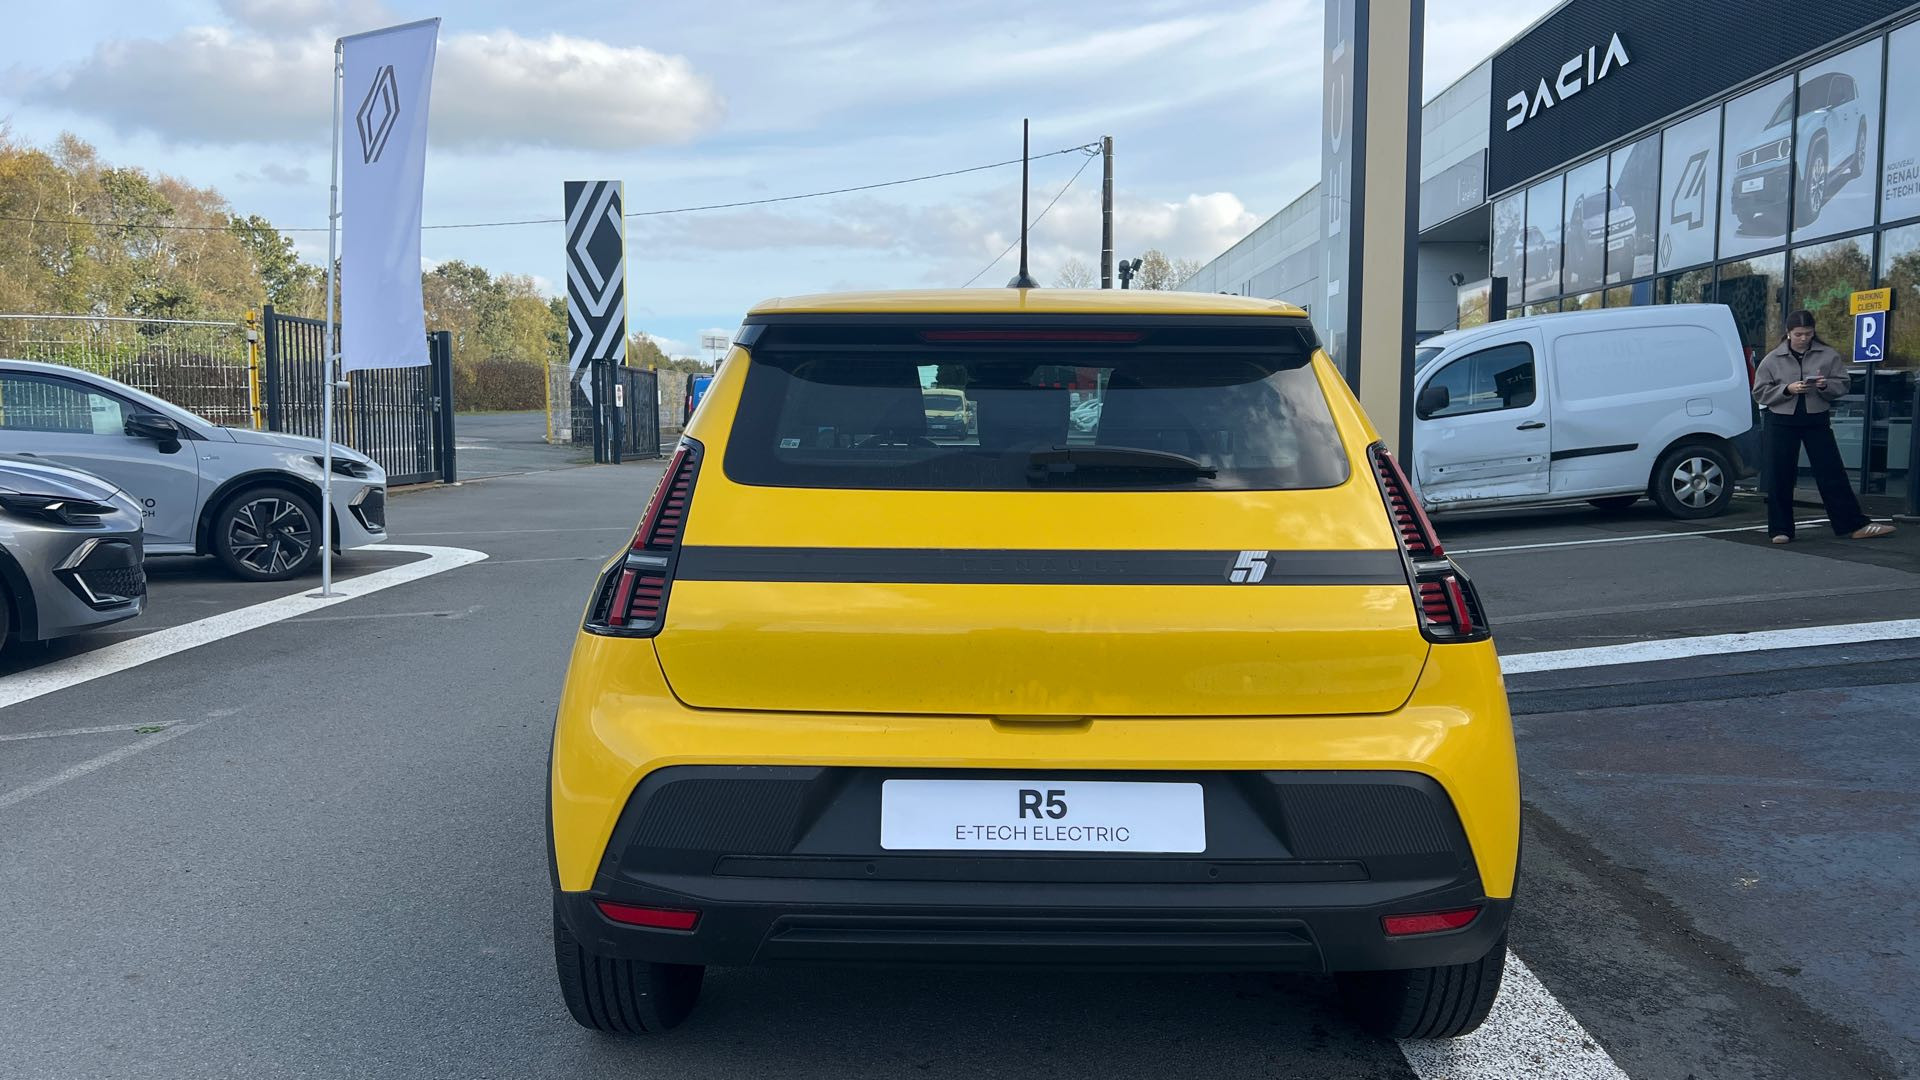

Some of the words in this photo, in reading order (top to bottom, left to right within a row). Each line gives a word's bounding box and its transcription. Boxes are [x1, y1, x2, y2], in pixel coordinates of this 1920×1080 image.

[1506, 31, 1630, 132] DACIA
[1857, 291, 1884, 301] PARKING
[1857, 301, 1883, 311] CLIENTS
[1862, 317, 1876, 348] P
[960, 558, 1130, 573] RENAULT
[1229, 550, 1269, 583] 5
[1019, 788, 1068, 820] R5
[955, 825, 1027, 842] E-TECH
[1033, 826, 1131, 843] ELECTRIC
